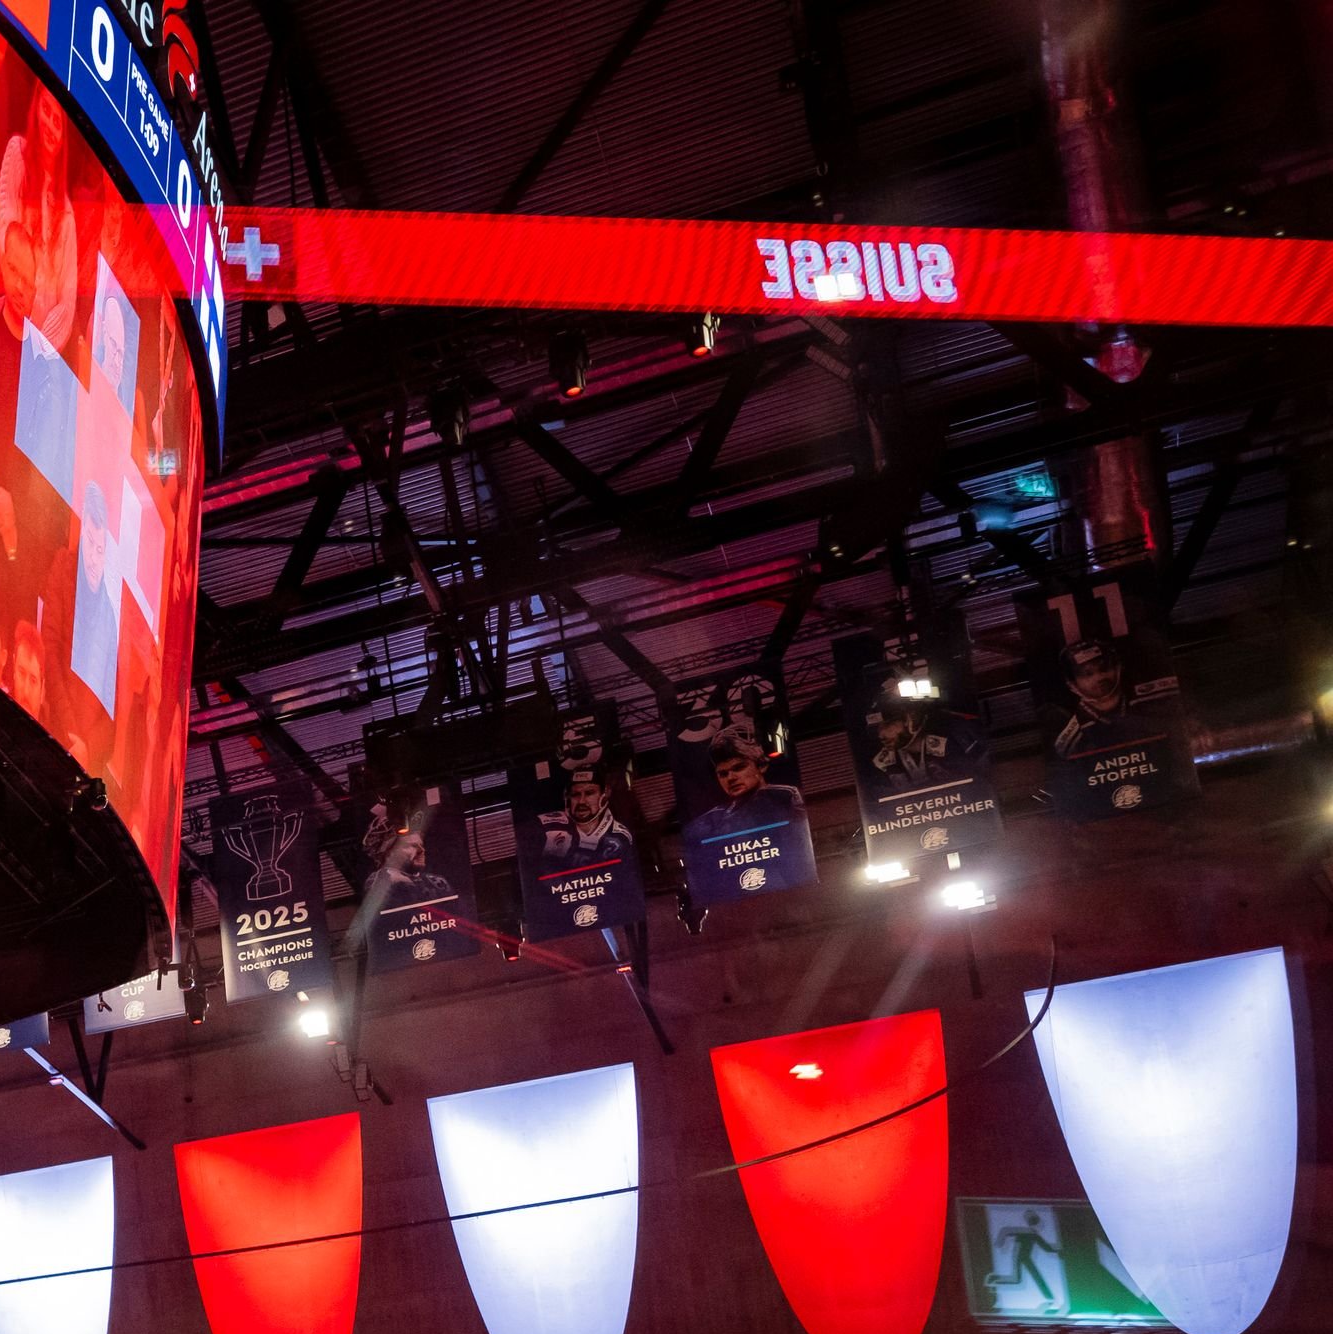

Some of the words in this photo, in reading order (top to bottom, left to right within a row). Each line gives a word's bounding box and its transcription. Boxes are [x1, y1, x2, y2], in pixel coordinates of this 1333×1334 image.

[91, 6, 114, 81] 0
[131, 62, 148, 101] PRE
[147, 92, 169, 142] GAME
[139, 108, 159, 157] 1:09
[176, 159, 192, 229] 0
[192, 111, 229, 261] Arena
[1093, 751, 1147, 773] ANDRI
[1087, 763, 1158, 786] STOFFEL
[895, 793, 962, 816] SEVERIN
[868, 800, 995, 835] BLINDENBACHER
[719, 847, 780, 869] FLÜELER
[724, 837, 771, 856] LUKAS
[551, 872, 613, 895] MATHIAS
[561, 886, 605, 904] SEGER
[236, 901, 309, 936] 2025
[388, 918, 457, 941] SULANDER
[410, 912, 432, 925] ARI
[237, 938, 313, 962] CHAMPIONS
[240, 959, 277, 972] HOCKEY
[278, 951, 314, 965] LEAGUE
[121, 985, 145, 998] CUP
